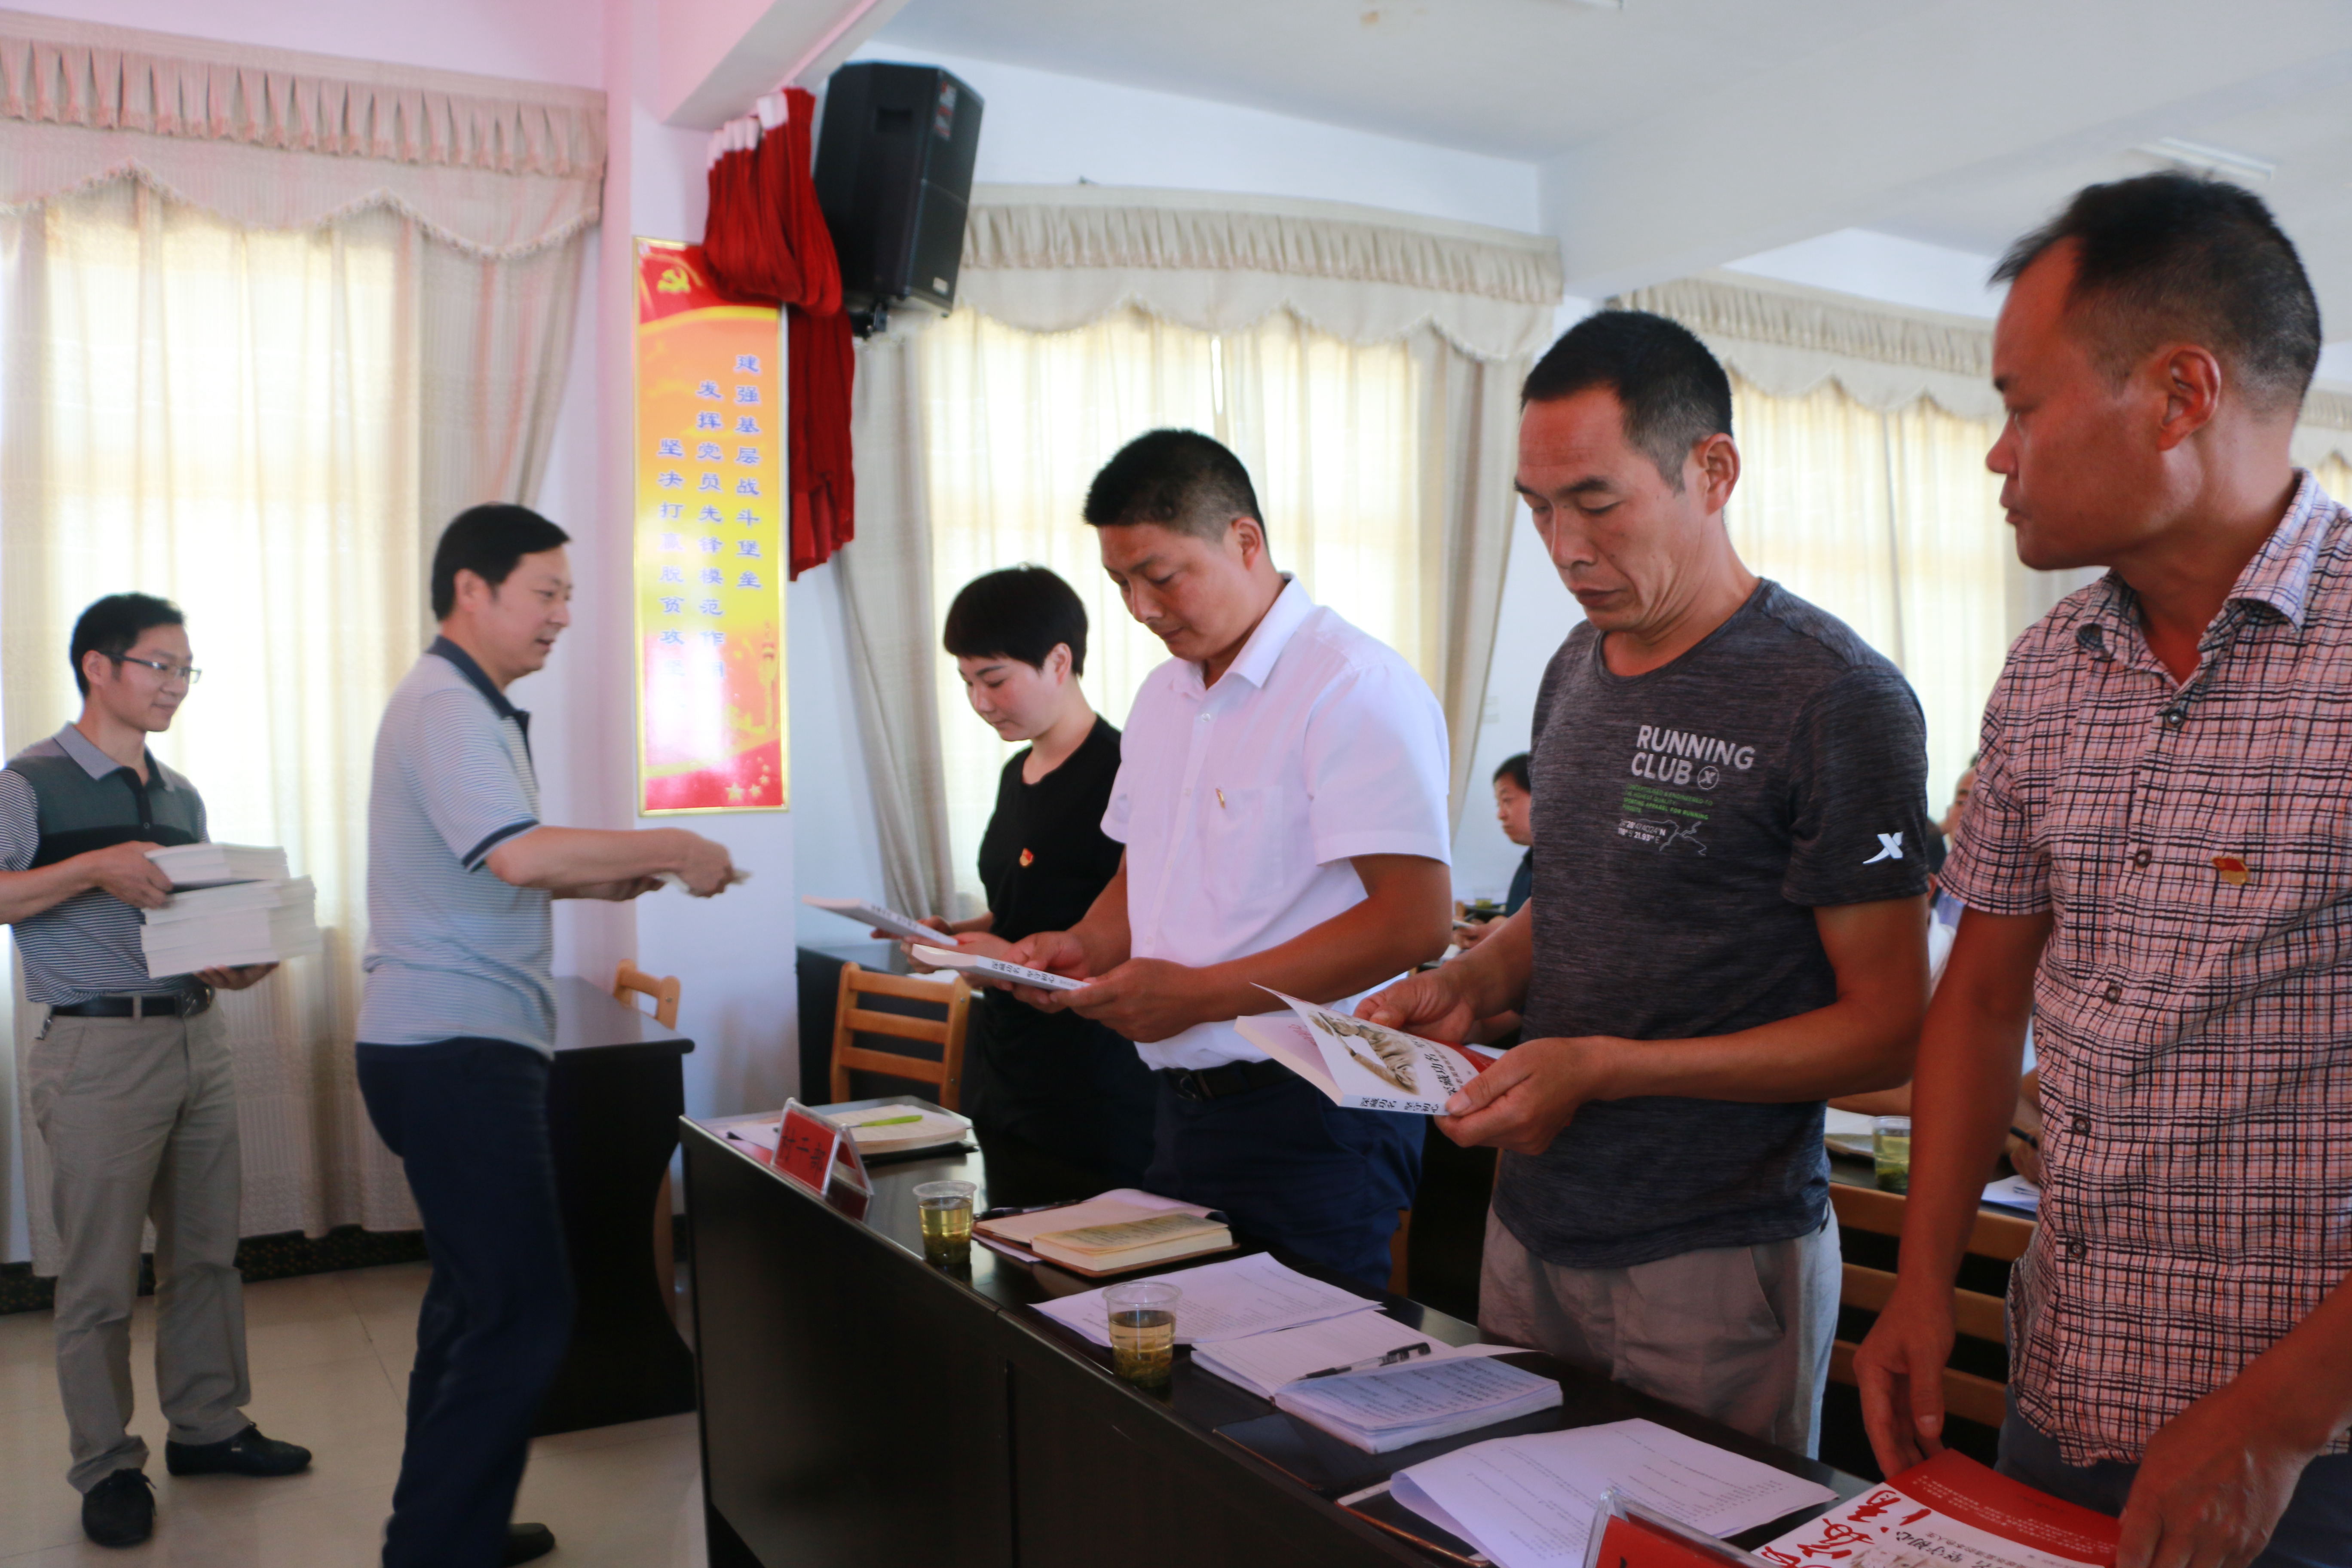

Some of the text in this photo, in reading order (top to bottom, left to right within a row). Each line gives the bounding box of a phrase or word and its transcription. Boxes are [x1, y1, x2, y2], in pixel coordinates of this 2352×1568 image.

[735, 355, 761, 588] 建强基层战斗堡垒
[658, 438, 686, 708] 坚决打赢脱贫攻坚
[1636, 725, 1755, 770] RUNNING
[1631, 751, 1692, 785] CLUB
[1645, 802, 1668, 812] APPAREL
[1682, 810, 1709, 820] RUNNING
[1360, 1096, 1439, 1113] 深藏功名 坚守初心
[1896, 1531, 1963, 1563] 坚守初心
